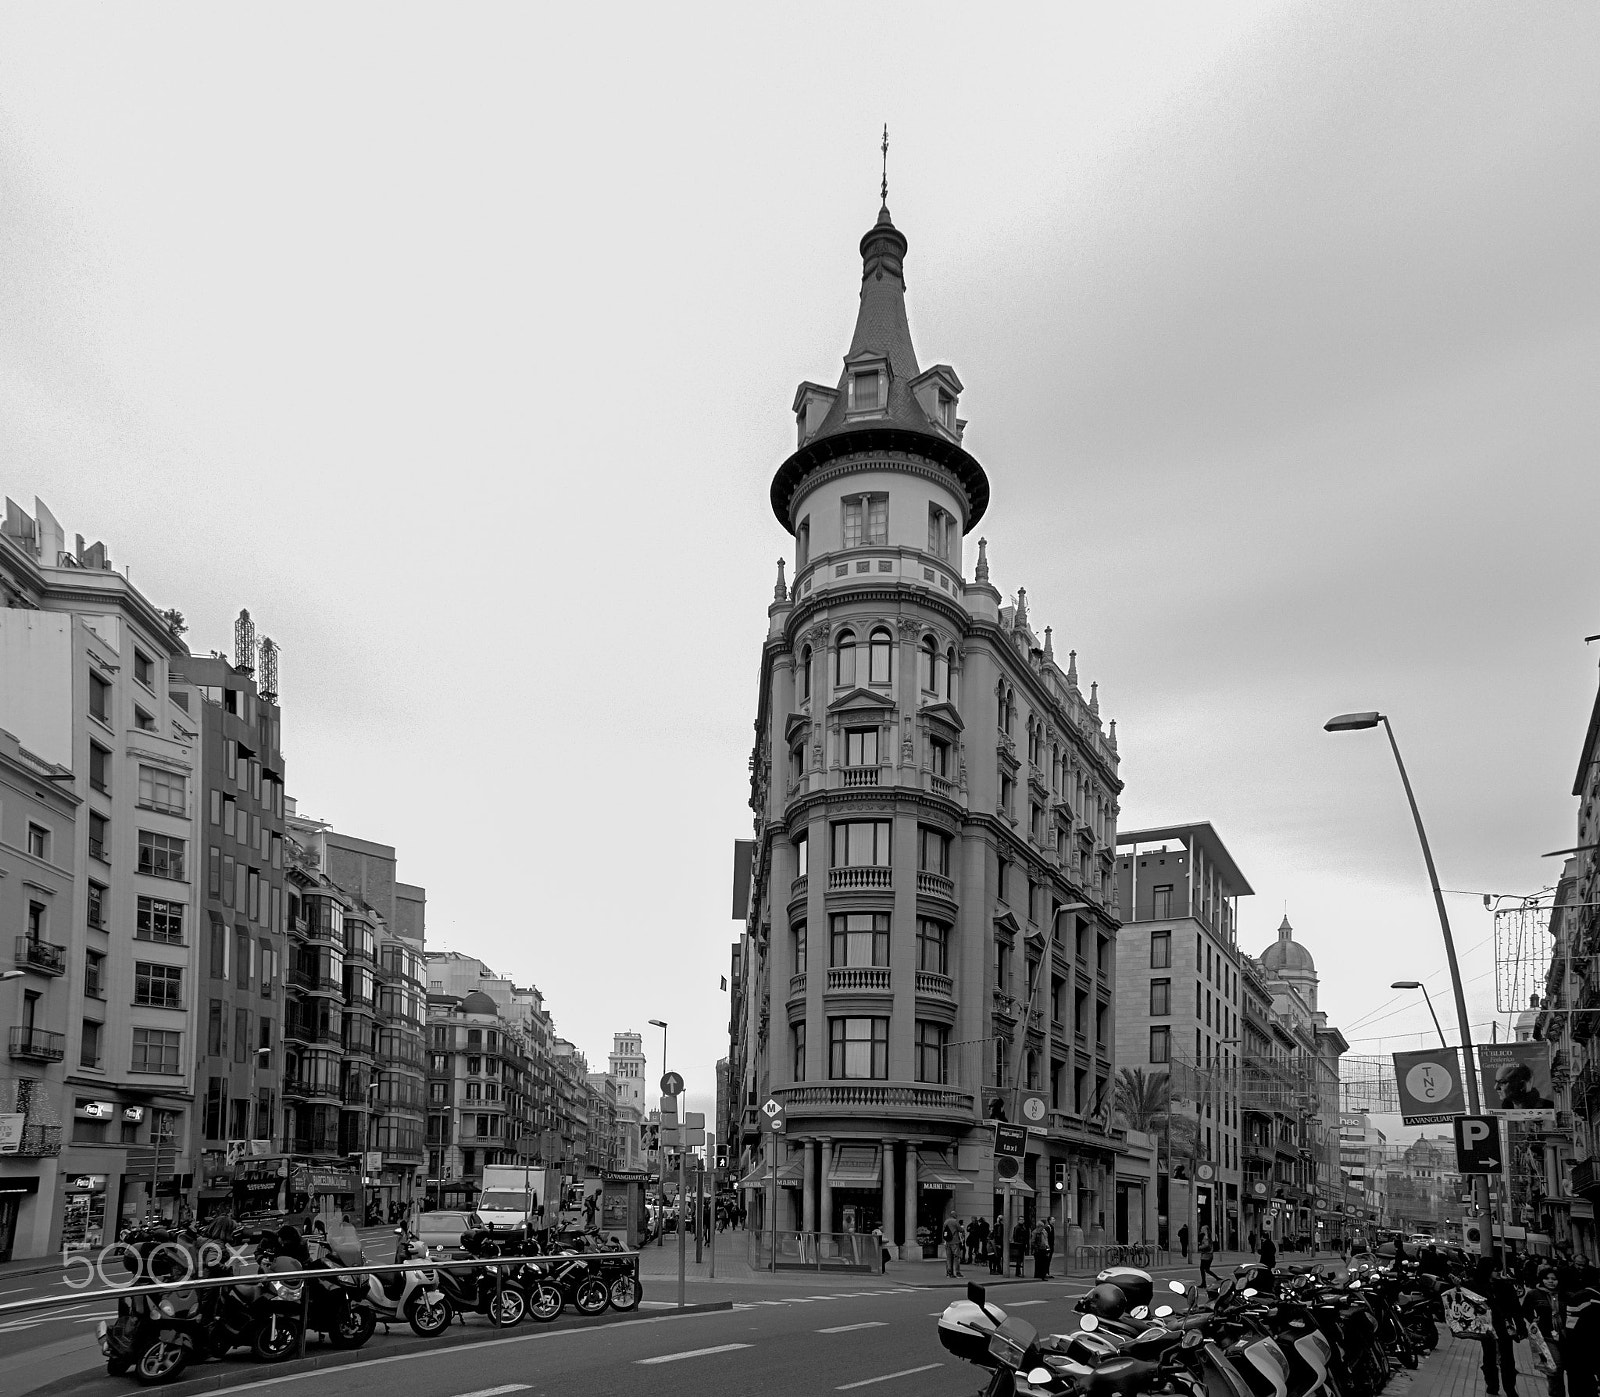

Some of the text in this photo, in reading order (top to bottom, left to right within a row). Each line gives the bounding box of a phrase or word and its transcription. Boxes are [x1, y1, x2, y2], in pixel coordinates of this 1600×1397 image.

[766, 1103, 776, 1113] M
[1462, 1120, 1490, 1151] P
[1003, 1144, 1018, 1152] taxi
